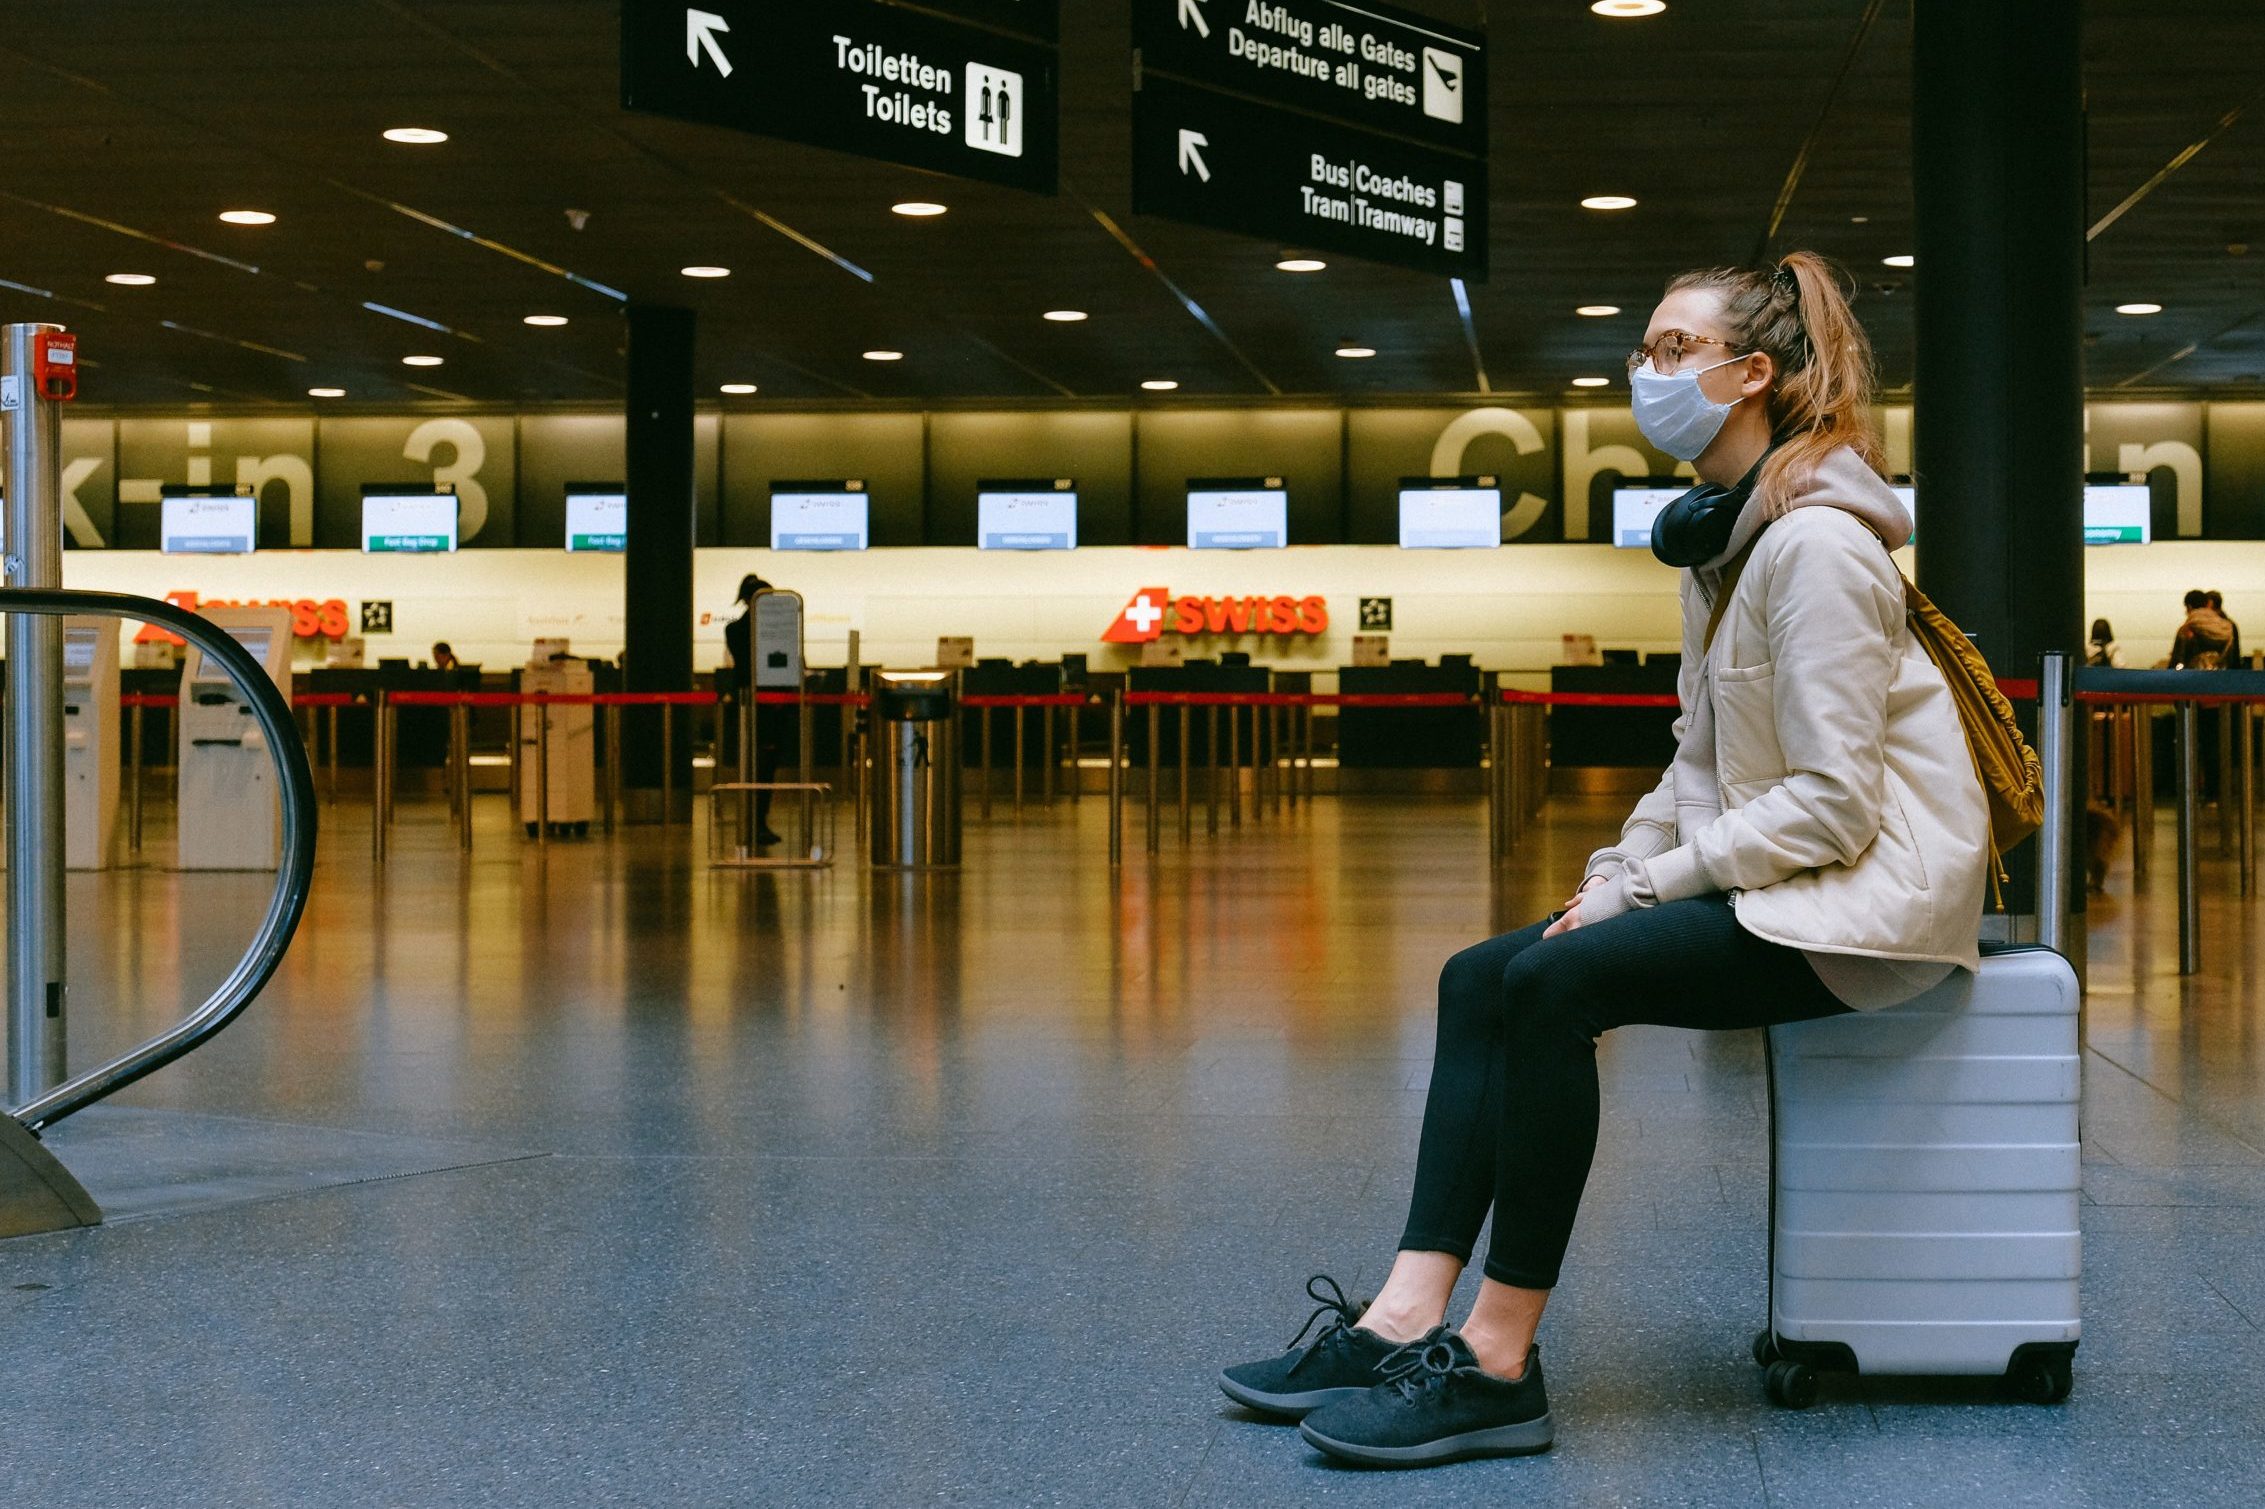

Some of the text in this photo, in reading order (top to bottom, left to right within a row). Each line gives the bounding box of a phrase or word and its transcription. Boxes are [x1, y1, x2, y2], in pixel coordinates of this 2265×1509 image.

[832, 34, 952, 95] Toiletten
[1229, 27, 1416, 106] Departure all gates
[1245, 0, 1416, 73] Abflug alle Gates
[861, 83, 952, 135] Toilets
[402, 417, 489, 545] 3
[1174, 595, 1329, 634] SWISS
